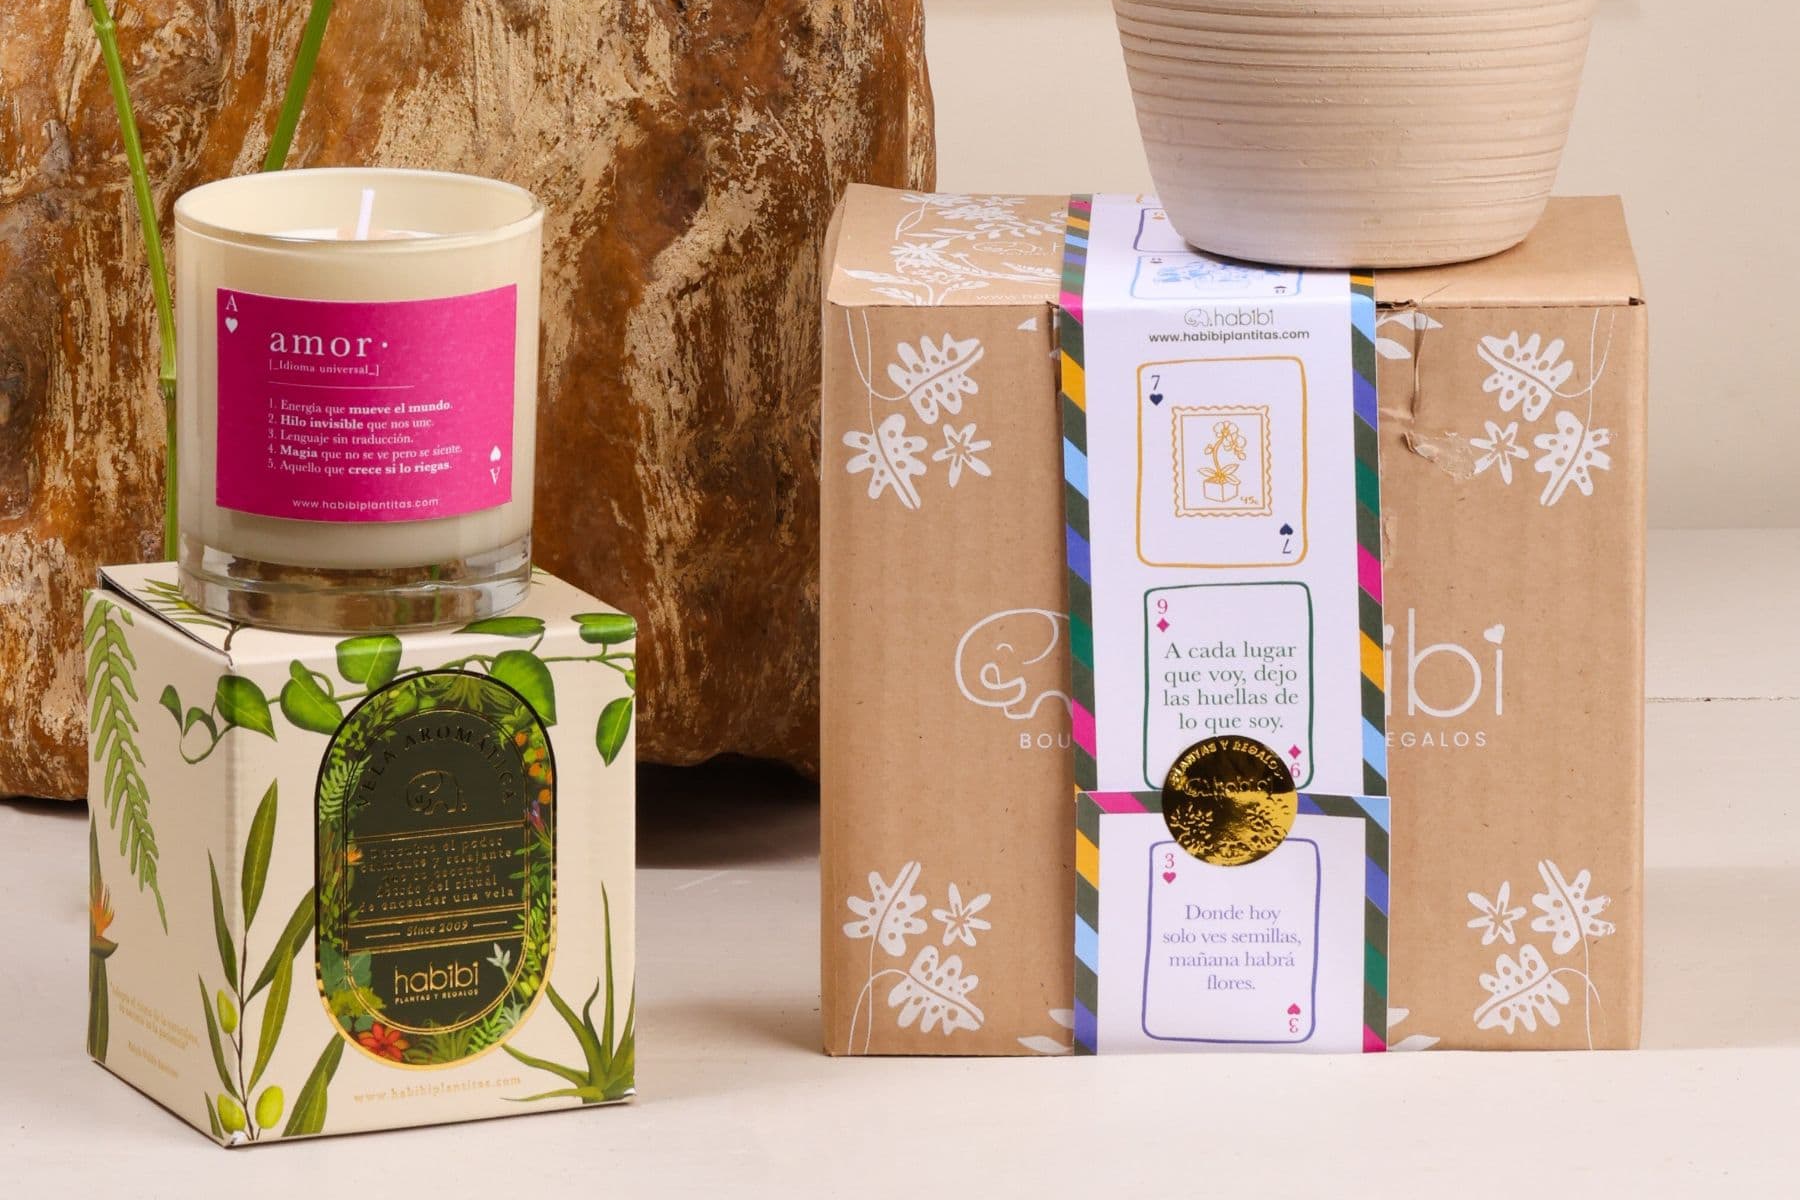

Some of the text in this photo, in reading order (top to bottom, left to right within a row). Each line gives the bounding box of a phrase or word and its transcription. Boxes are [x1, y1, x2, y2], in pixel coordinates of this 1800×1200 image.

[225, 294, 239, 312] A
[1214, 308, 1274, 327] habibi
[1149, 329, 1310, 344] www.habibiplantitas.com
[1151, 375, 1161, 391] 7
[325, 404, 346, 416] que
[349, 404, 391, 415] mueve
[394, 401, 406, 414] el
[408, 400, 454, 413] mundo.
[268, 413, 277, 424] 2.
[280, 414, 307, 428] Hilo
[310, 418, 364, 430] invisible
[366, 421, 387, 432] que
[390, 419, 410, 429] nos
[280, 429, 330, 444] Lenguaje
[332, 433, 349, 444] sin
[351, 432, 414, 444] traducción.
[280, 444, 318, 460] Magia
[321, 449, 342, 461] que
[345, 450, 360, 460] no
[362, 450, 375, 460] se
[377, 450, 390, 460] ve
[392, 449, 417, 461] pero
[419, 448, 431, 458] se
[280, 460, 322, 475] Aquello
[324, 465, 345, 476] que
[348, 465, 382, 475] crece
[399, 461, 412, 473] lo
[414, 461, 453, 474] riegas.
[292, 498, 439, 512] www.habibiplantitas.com
[1281, 538, 1292, 554] 7
[1157, 598, 1169, 615] 9
[1164, 640, 1297, 662] A cada lugar
[1384, 607, 1506, 718] ibi
[1164, 664, 1298, 688] que voy, dejo
[1164, 687, 1299, 706] las huellas de
[1178, 712, 1284, 734] lo que soy.
[1020, 733, 1071, 749] BOU
[1386, 731, 1488, 748] EGALOS
[1165, 853, 1175, 869] 3
[1185, 904, 1281, 925] Donde hoy
[406, 920, 469, 937] Since 2009
[1162, 927, 1302, 947] solo ves semillas,
[1169, 950, 1296, 968] mañana habrá
[394, 960, 479, 995] habibi
[1206, 974, 1256, 991] flores.
[1288, 1017, 1299, 1034] 3
